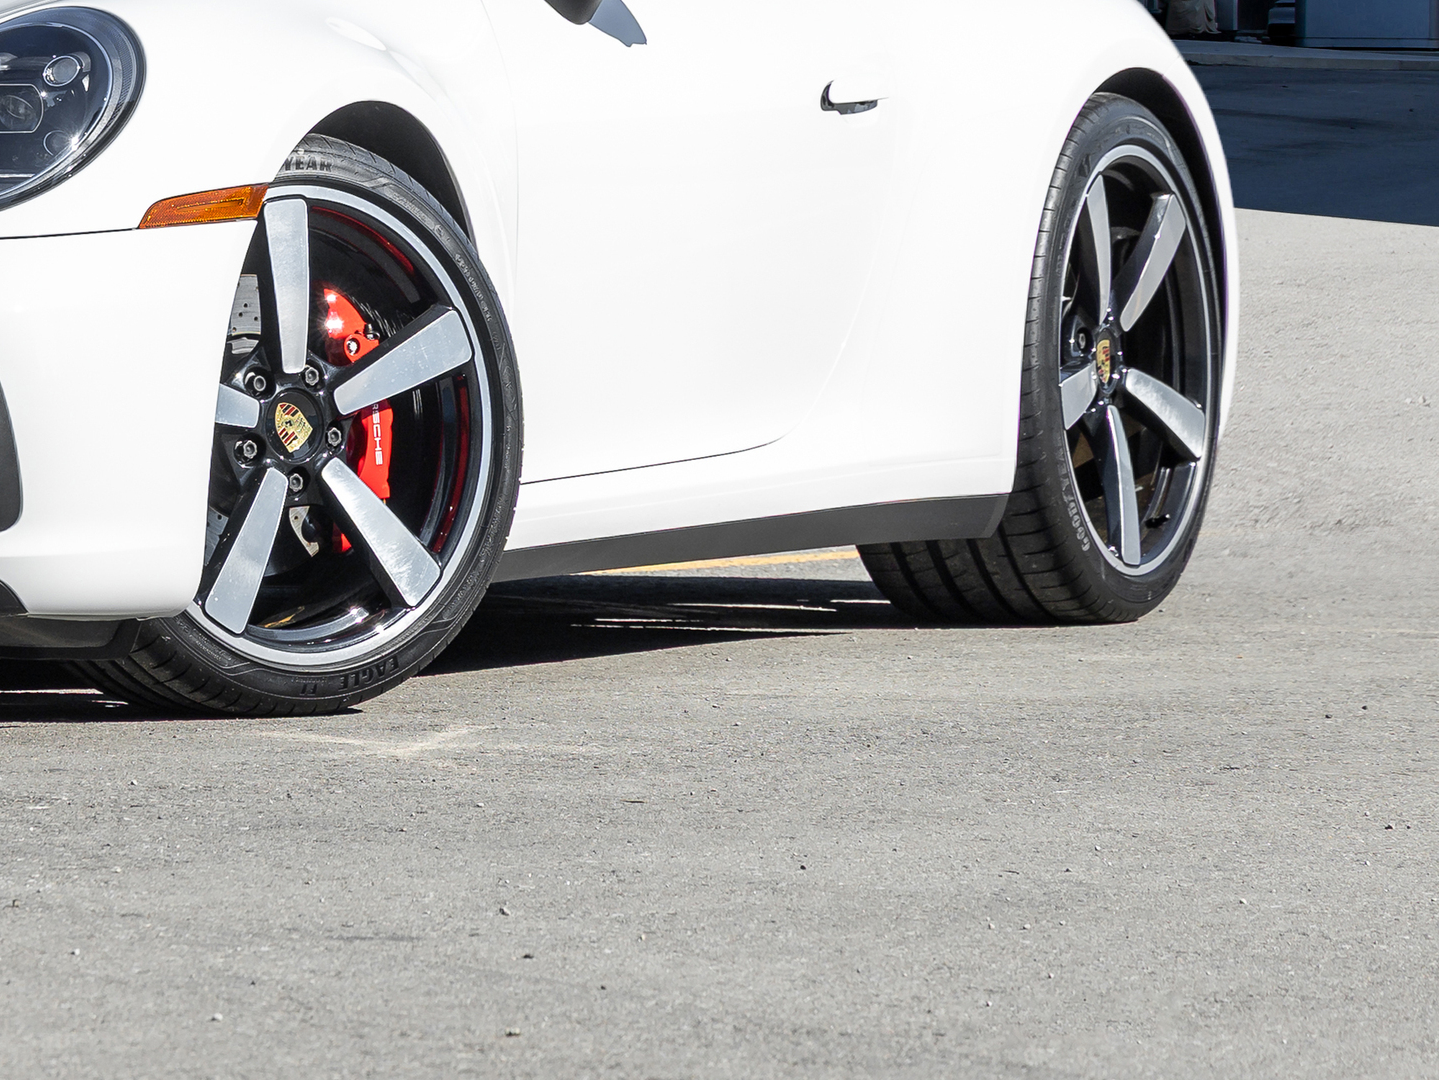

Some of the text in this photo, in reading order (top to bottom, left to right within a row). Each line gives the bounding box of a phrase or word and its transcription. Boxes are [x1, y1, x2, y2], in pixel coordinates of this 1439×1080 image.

[283, 155, 332, 172] YEAR
[372, 403, 383, 466] RSCHE
[338, 655, 400, 692] EAGLE
